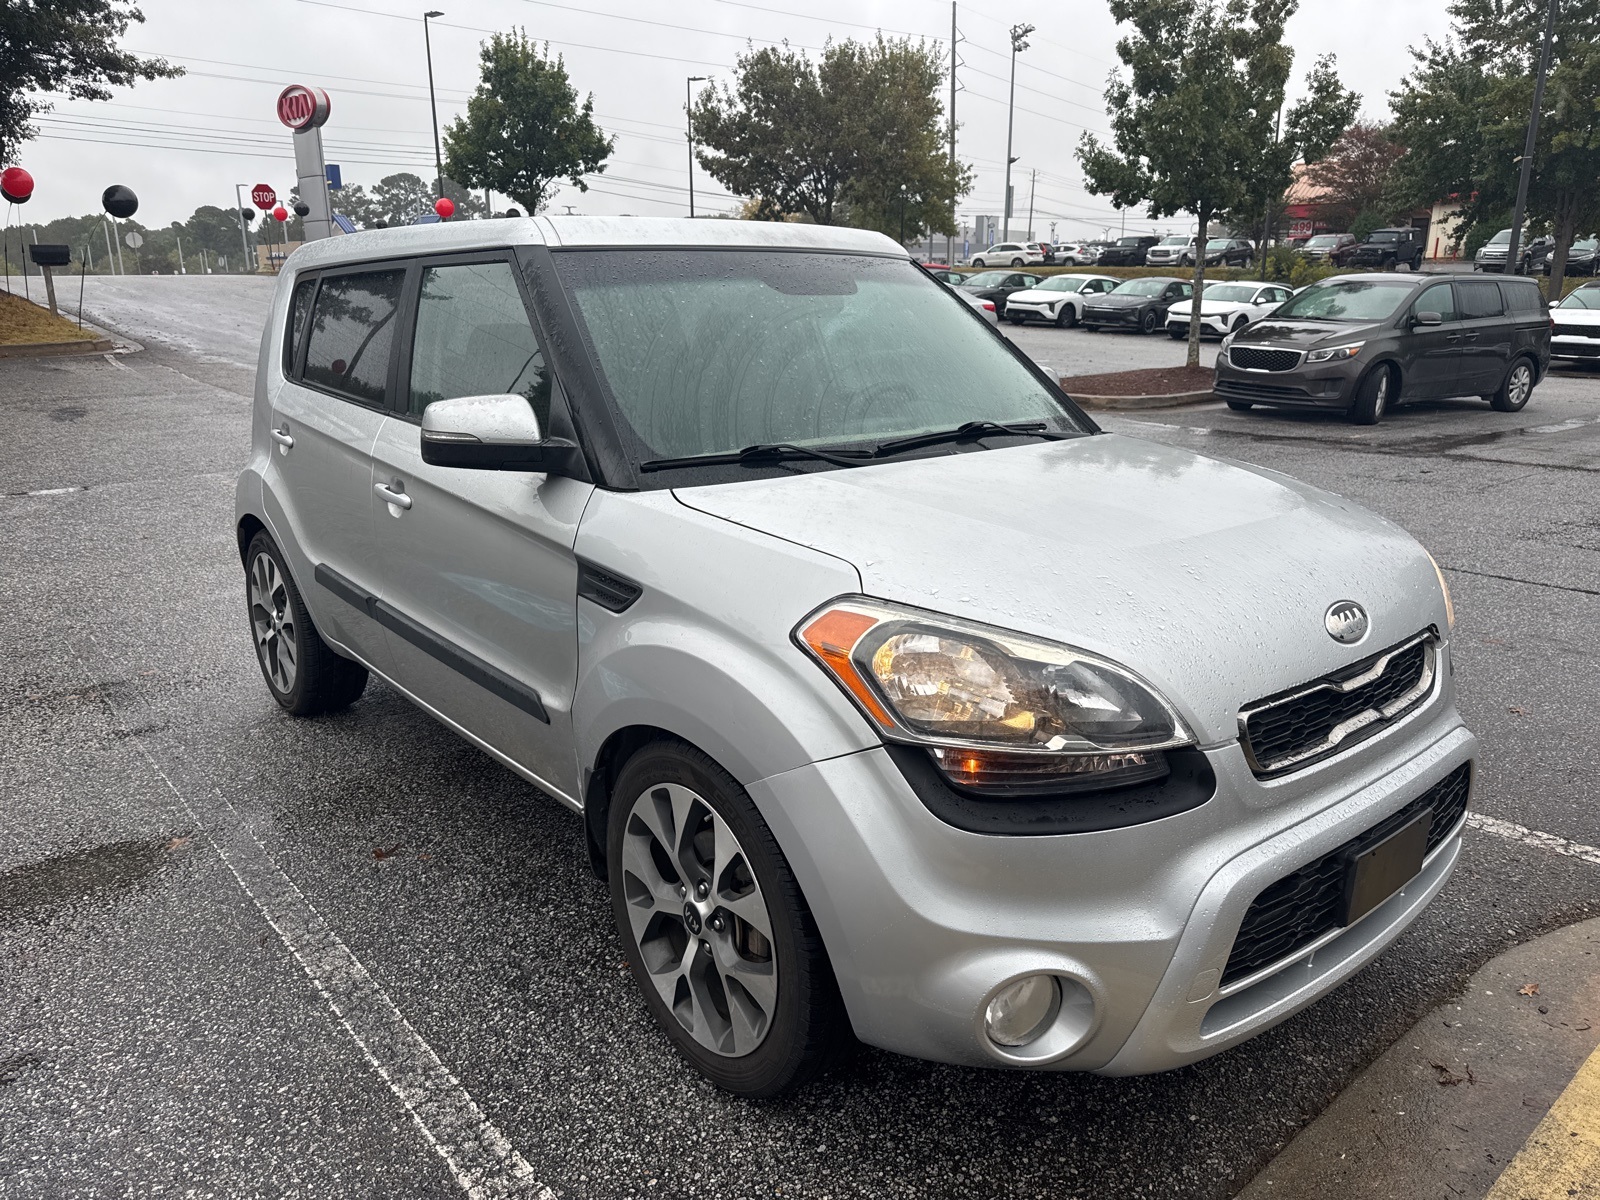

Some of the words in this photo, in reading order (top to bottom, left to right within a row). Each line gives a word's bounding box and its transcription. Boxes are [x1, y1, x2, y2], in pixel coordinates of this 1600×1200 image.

[281, 94, 311, 122] KIA
[253, 191, 275, 203] STOP
[1329, 607, 1366, 637] KIA
[684, 905, 700, 932] KIA
